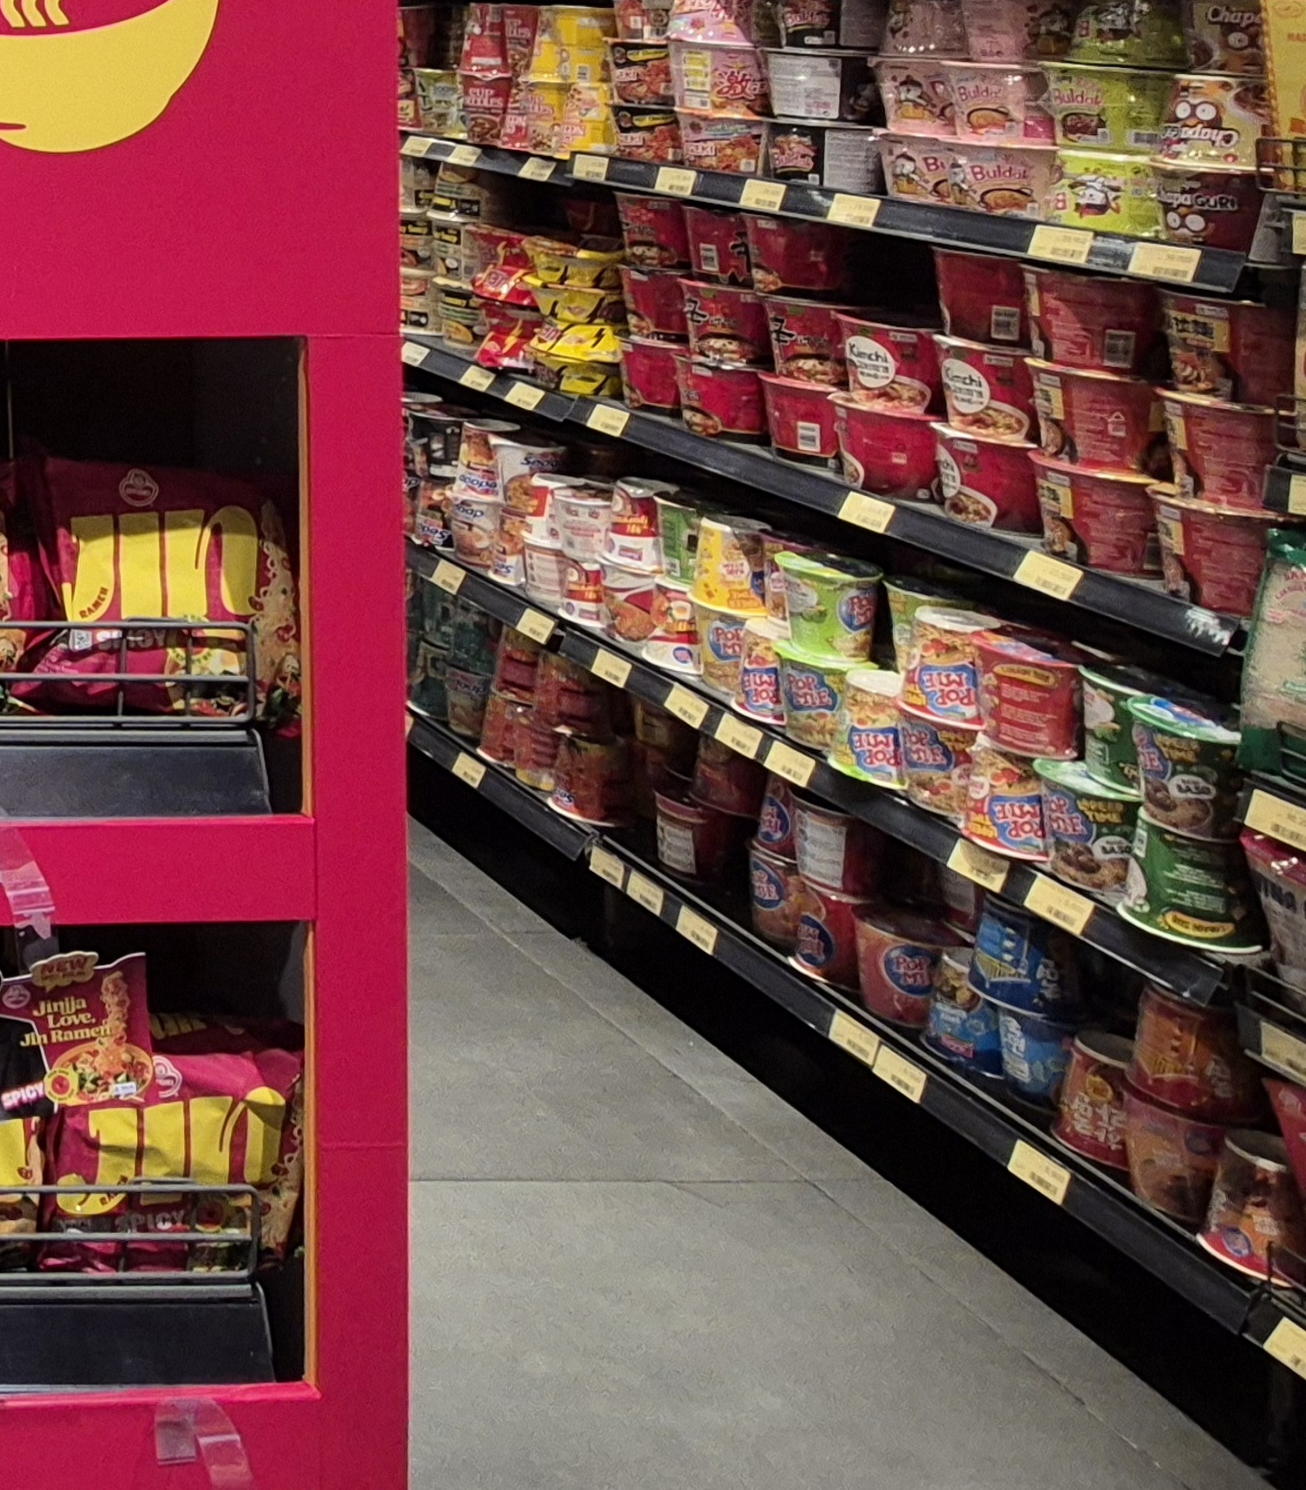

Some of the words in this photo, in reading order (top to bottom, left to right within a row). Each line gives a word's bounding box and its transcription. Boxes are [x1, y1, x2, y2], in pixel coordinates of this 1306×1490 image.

[849, 341, 888, 363] Kimchi
[937, 687, 976, 708] POP
[39, 957, 89, 976] NEW
[32, 996, 87, 1017] Jinjja
[19, 1032, 50, 1047] Jin
[51, 1024, 112, 1043] Ramen
[1, 1081, 45, 1109] SPICY
